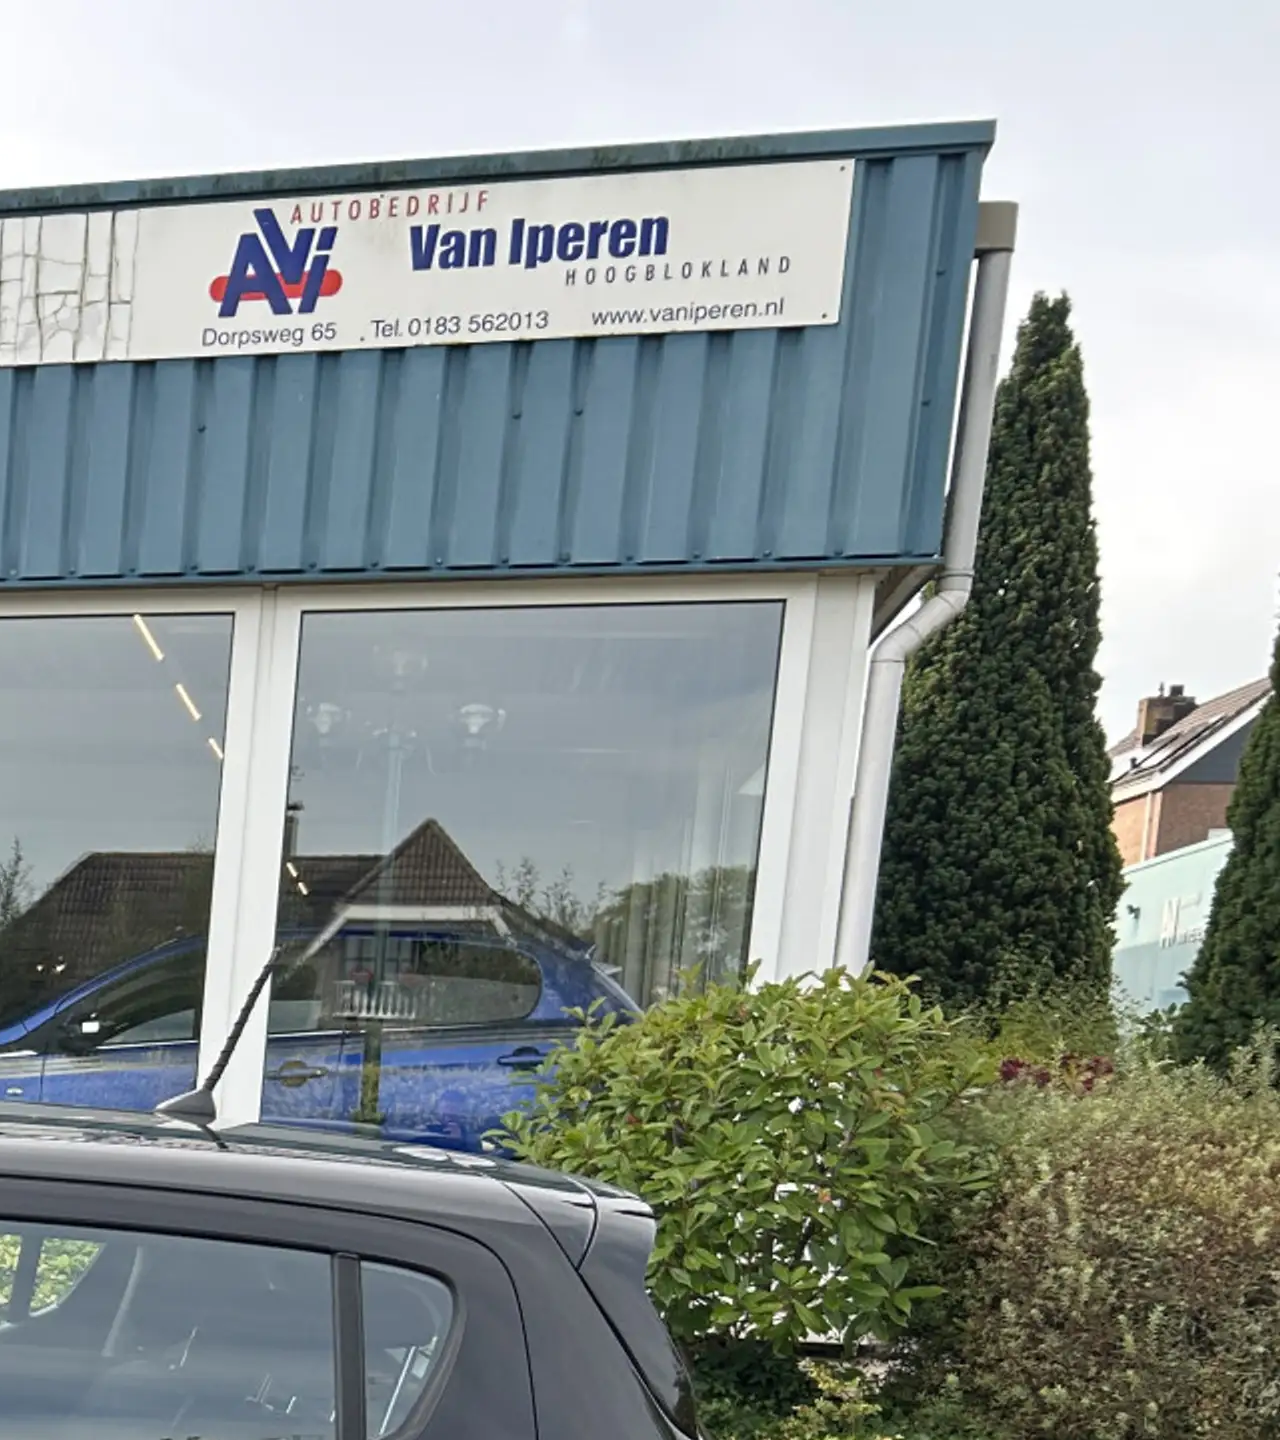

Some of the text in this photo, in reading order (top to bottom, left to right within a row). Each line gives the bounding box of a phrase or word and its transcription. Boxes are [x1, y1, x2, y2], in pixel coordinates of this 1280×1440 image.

[290, 190, 489, 224] AUTOBEDRIJF
[410, 217, 669, 271] Van Iperen
[565, 255, 791, 286] HOOGBLOKLAND
[201, 297, 785, 349] Dorpsweg 65 Tel. 0183 562013 www.vaniperen.nl
